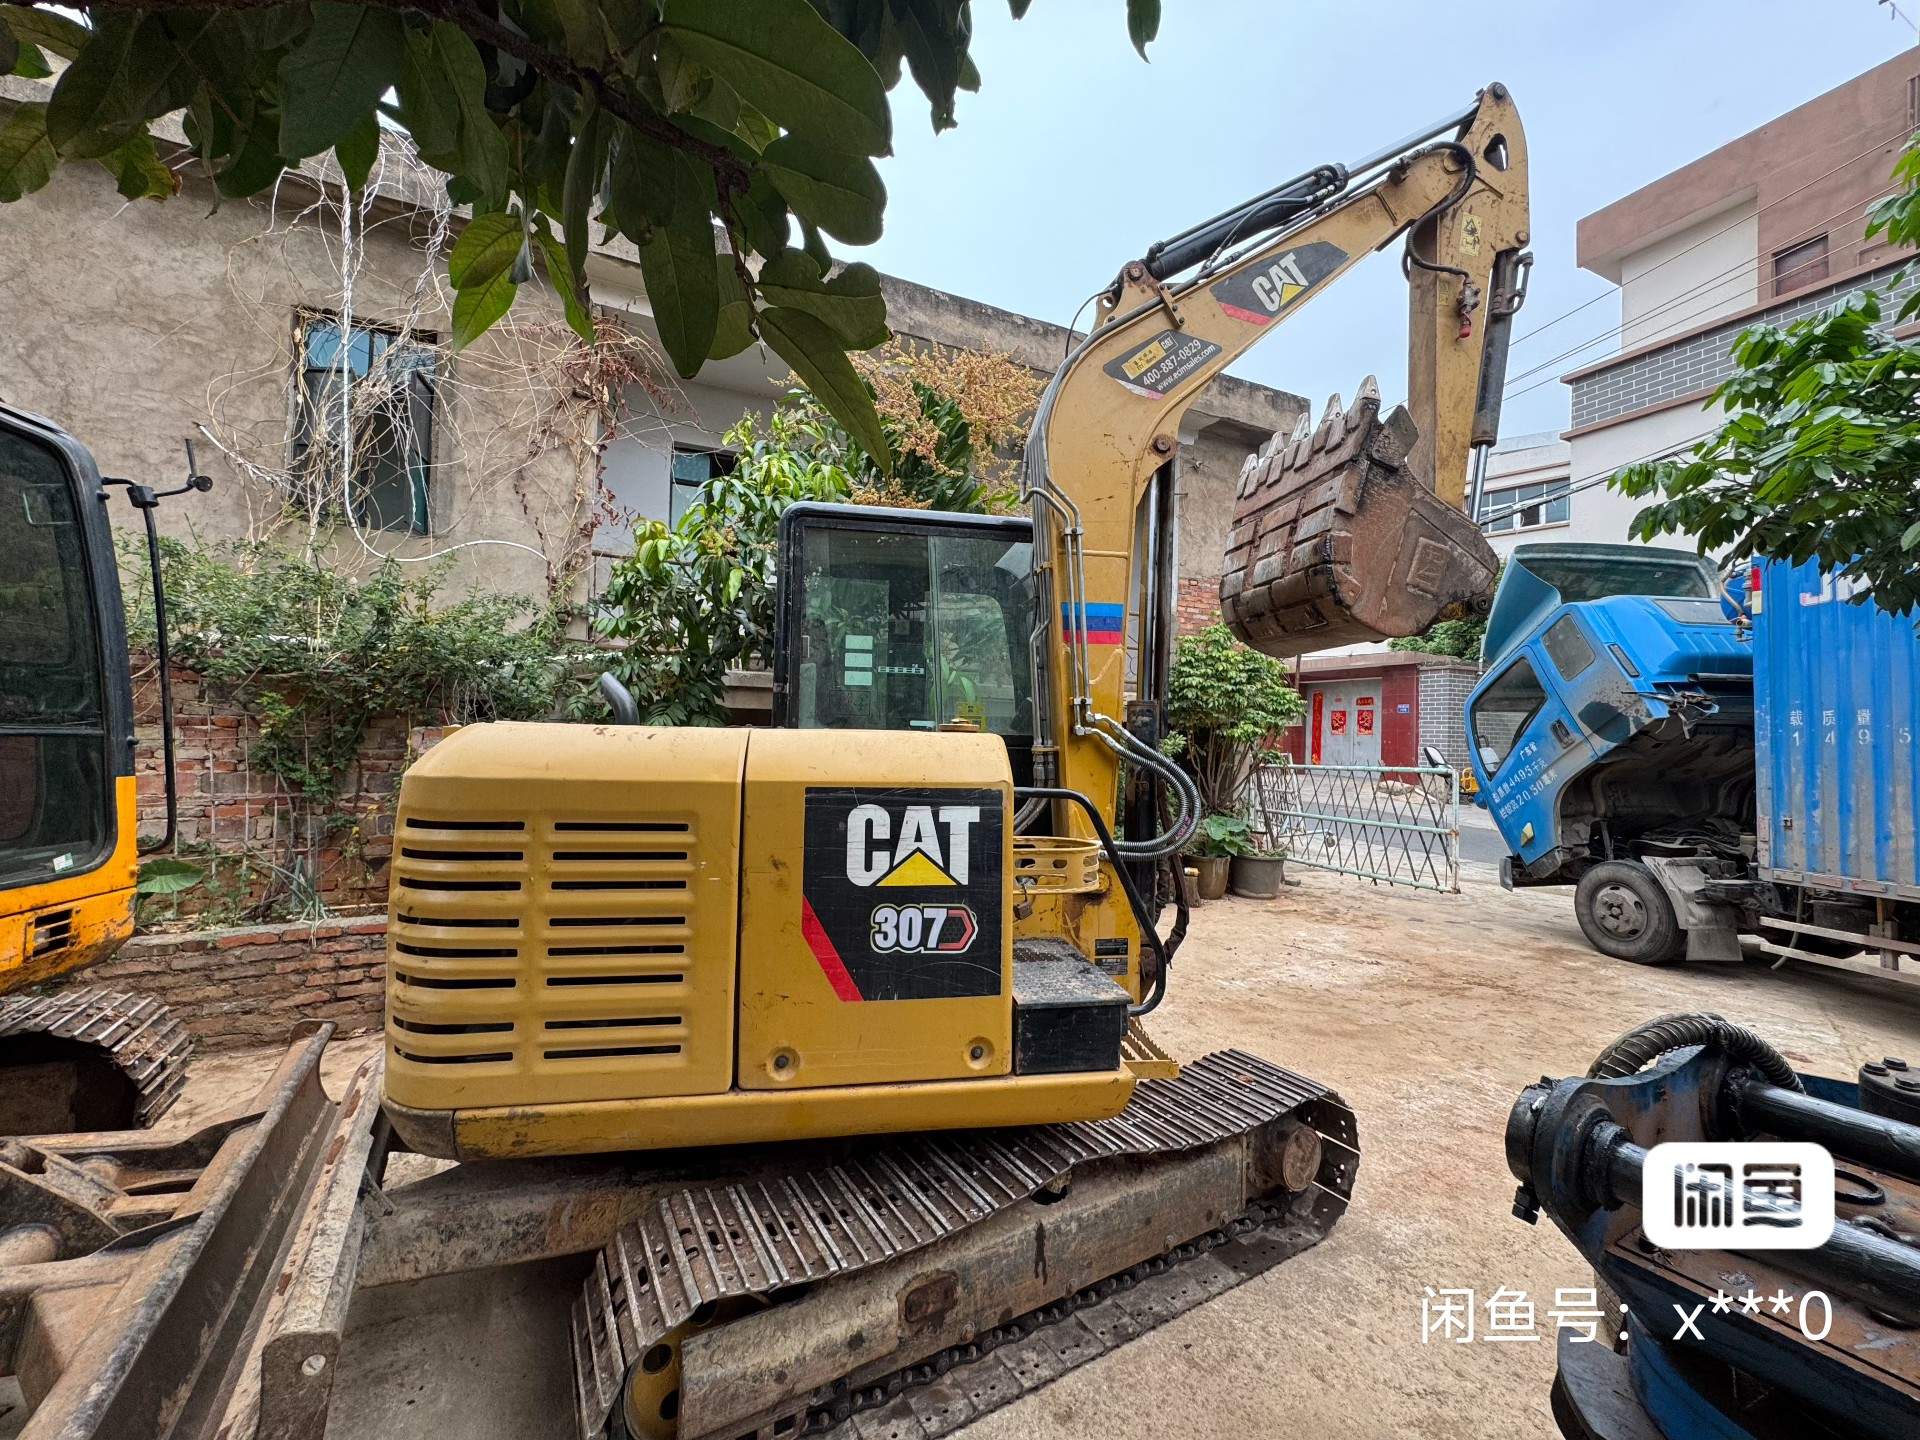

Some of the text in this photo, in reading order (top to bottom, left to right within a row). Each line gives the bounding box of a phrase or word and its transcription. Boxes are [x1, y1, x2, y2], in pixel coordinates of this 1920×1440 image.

[1252, 252, 1309, 312] CAT
[1143, 339, 1201, 386] 400-887-0829
[1161, 337, 1174, 350] CAT
[846, 803, 981, 887] CAT
[873, 905, 977, 951] 307D
